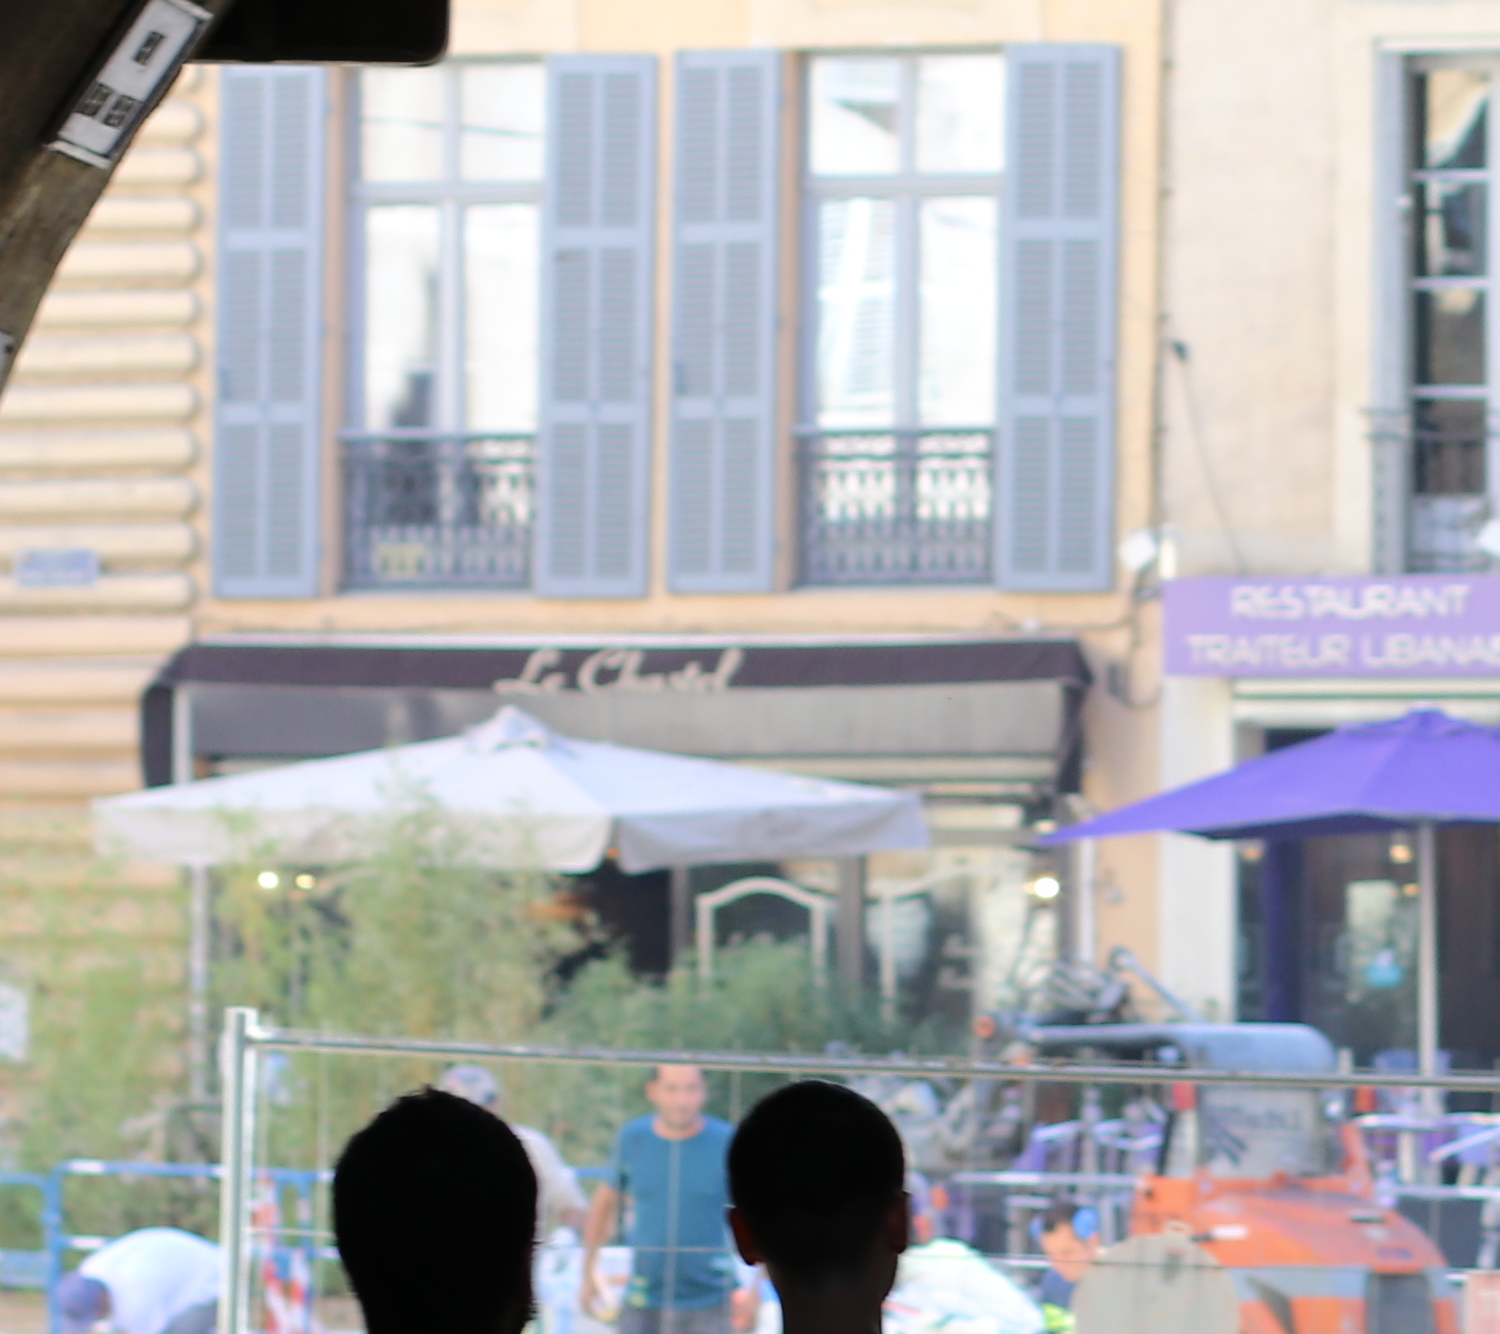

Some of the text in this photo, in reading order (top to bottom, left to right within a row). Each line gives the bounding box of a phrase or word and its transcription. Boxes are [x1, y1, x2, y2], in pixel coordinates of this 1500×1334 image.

[1231, 584, 1472, 619] RESTAURANT
[1186, 633, 1352, 667] TRAITEUR
[493, 647, 566, 696] Le
